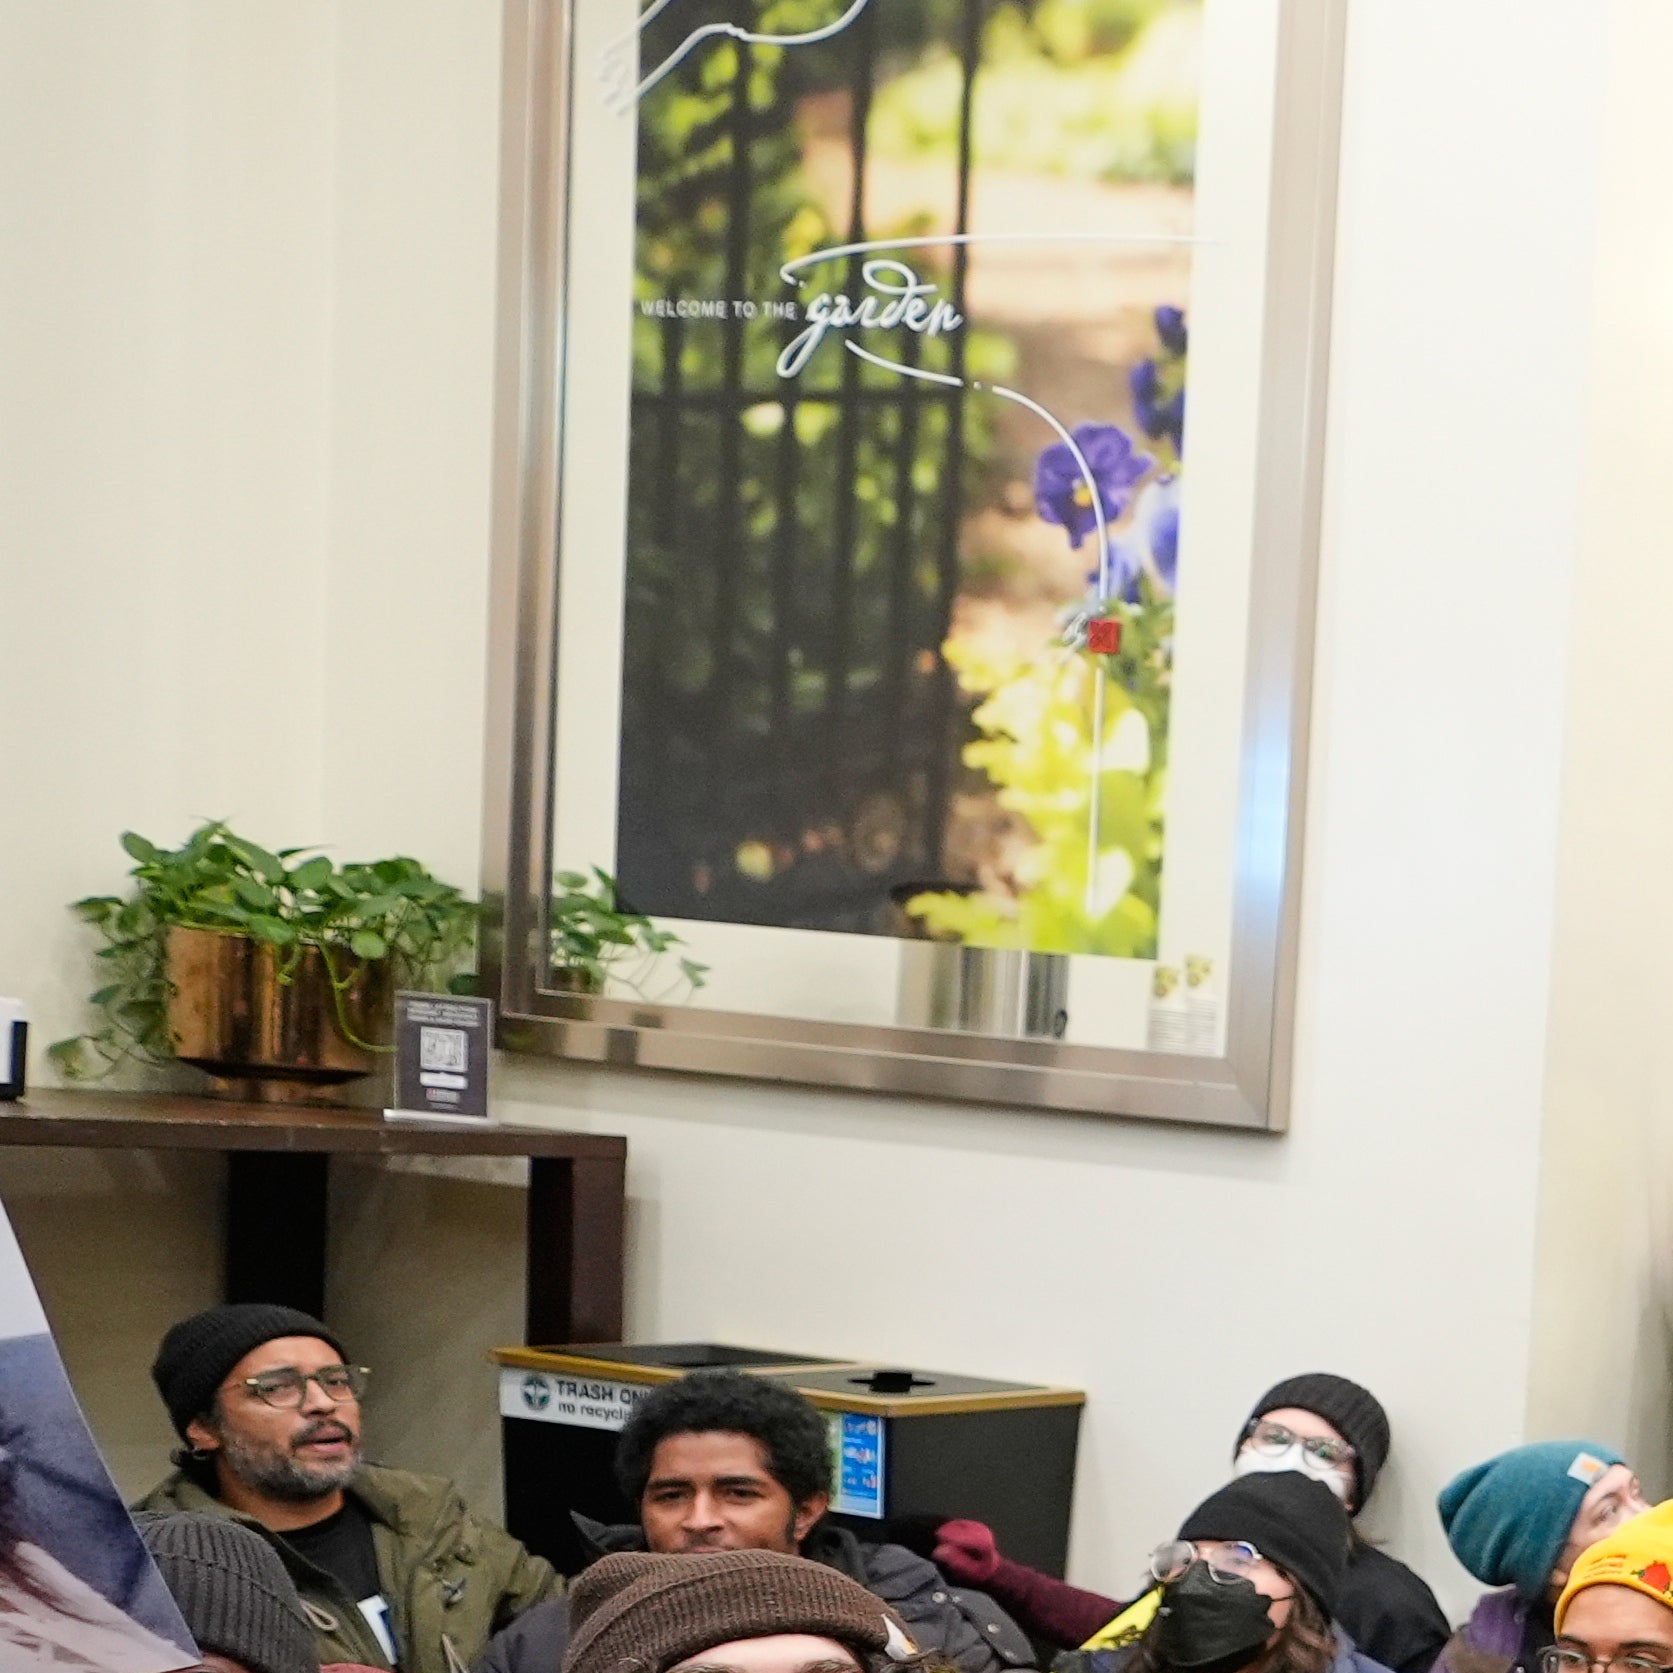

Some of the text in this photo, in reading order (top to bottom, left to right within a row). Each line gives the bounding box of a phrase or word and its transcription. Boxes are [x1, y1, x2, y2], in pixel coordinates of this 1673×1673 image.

[640, 259, 963, 379] WELCOME TO THE garden
[555, 1379, 613, 1402] TRASH
[558, 1402, 628, 1422] no recycl
